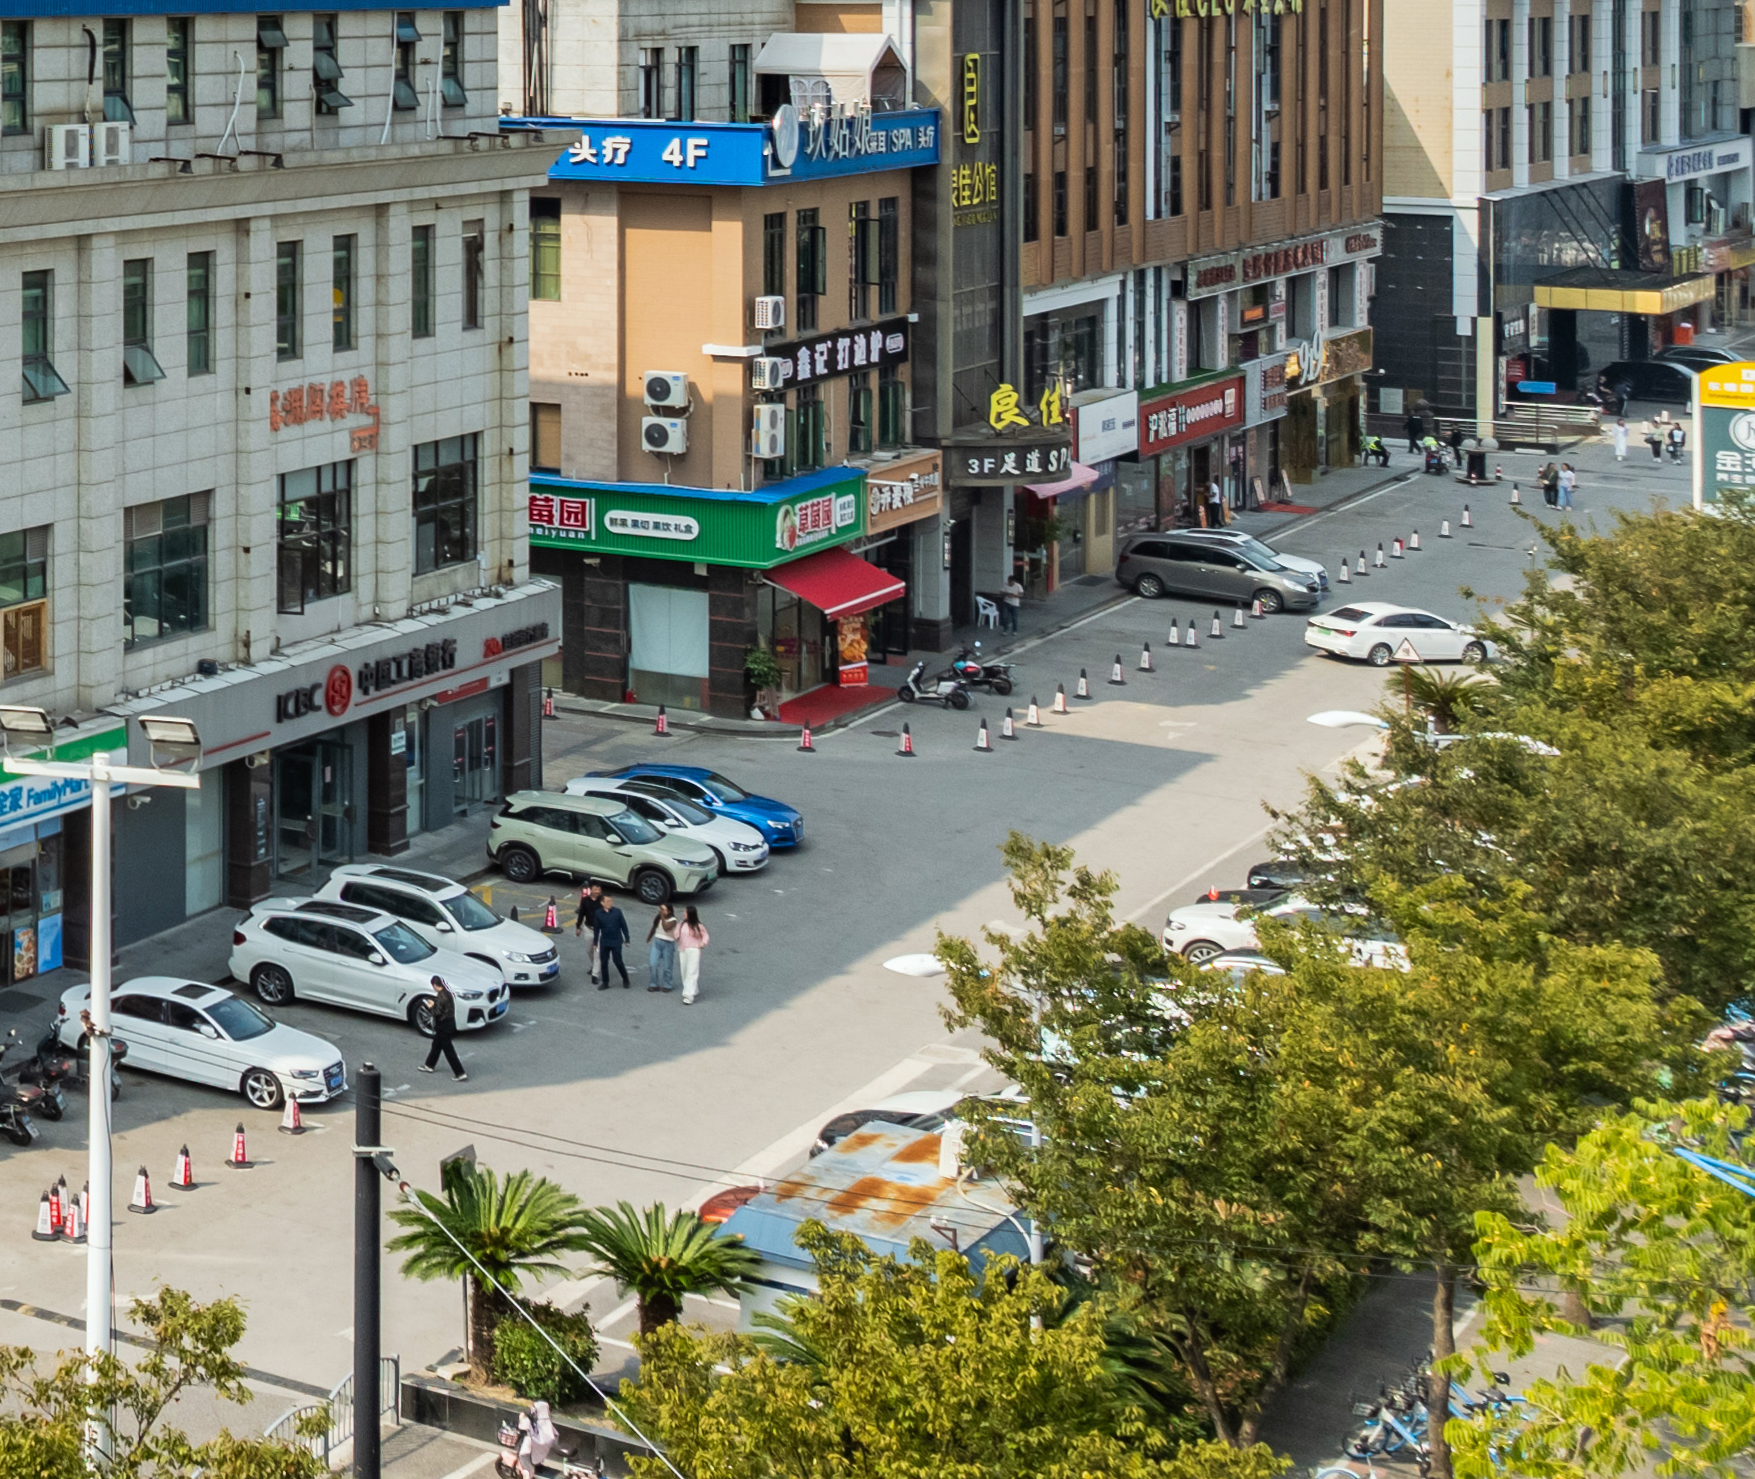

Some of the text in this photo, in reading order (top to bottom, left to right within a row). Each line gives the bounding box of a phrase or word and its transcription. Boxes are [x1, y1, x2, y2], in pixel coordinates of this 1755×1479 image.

[569, 135, 709, 168] 头疗 4F
[891, 127, 913, 153] SPA
[990, 381, 1063, 430] 良佳
[967, 458, 995, 474] 3F
[1000, 449, 1043, 474] 足道
[797, 496, 832, 535] 草莓园
[358, 638, 457, 695] 中国工商银行
[276, 683, 322, 723] ICBC
[26, 778, 90, 808] FamilyMart
